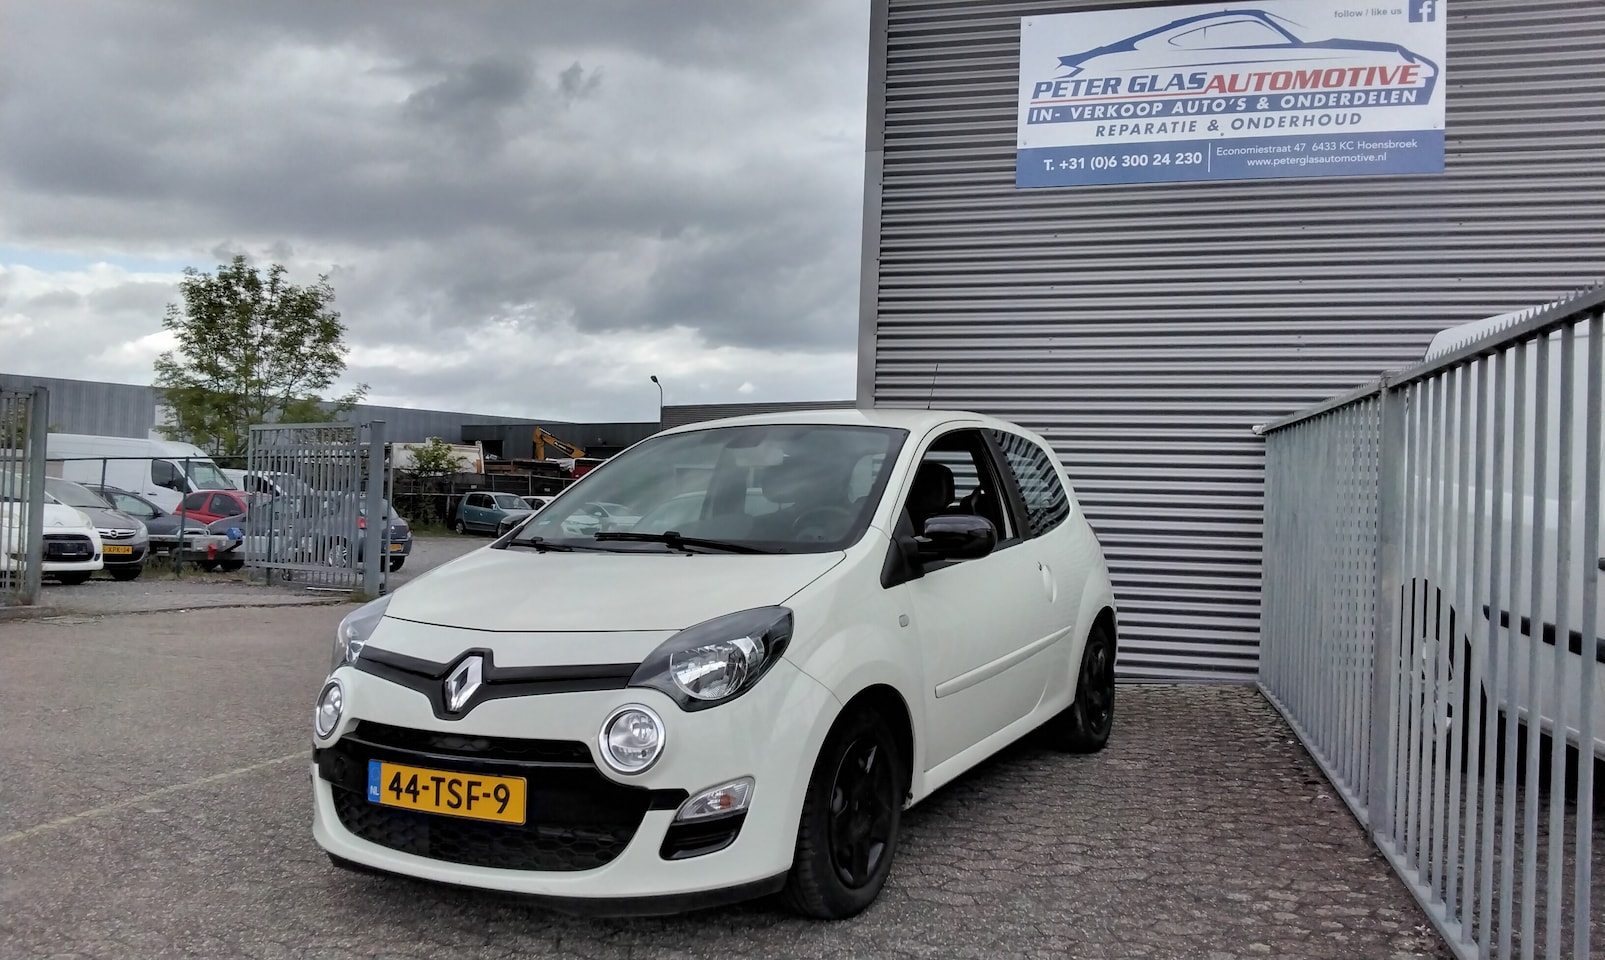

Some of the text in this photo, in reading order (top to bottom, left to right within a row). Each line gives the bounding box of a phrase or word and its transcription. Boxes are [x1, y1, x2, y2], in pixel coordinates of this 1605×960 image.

[1334, 10, 1363, 18] follow
[1371, 8, 1388, 16] like
[1032, 77, 1122, 100] PETER
[1032, 90, 1417, 122] IN- VERKOOP AUTO'S & ONDERDELEN
[1095, 112, 1362, 138] REPARATIE & ONDERHOUD
[1216, 139, 1418, 156] Economiestraat 47 6433 KC Hoensbroek
[1043, 152, 1203, 171] T. +31 (0)6 300 24 230
[1247, 152, 1387, 167] www.peterglasautomotive.nl
[370, 785, 380, 796] NL
[388, 771, 511, 814] 44-TSF-9
